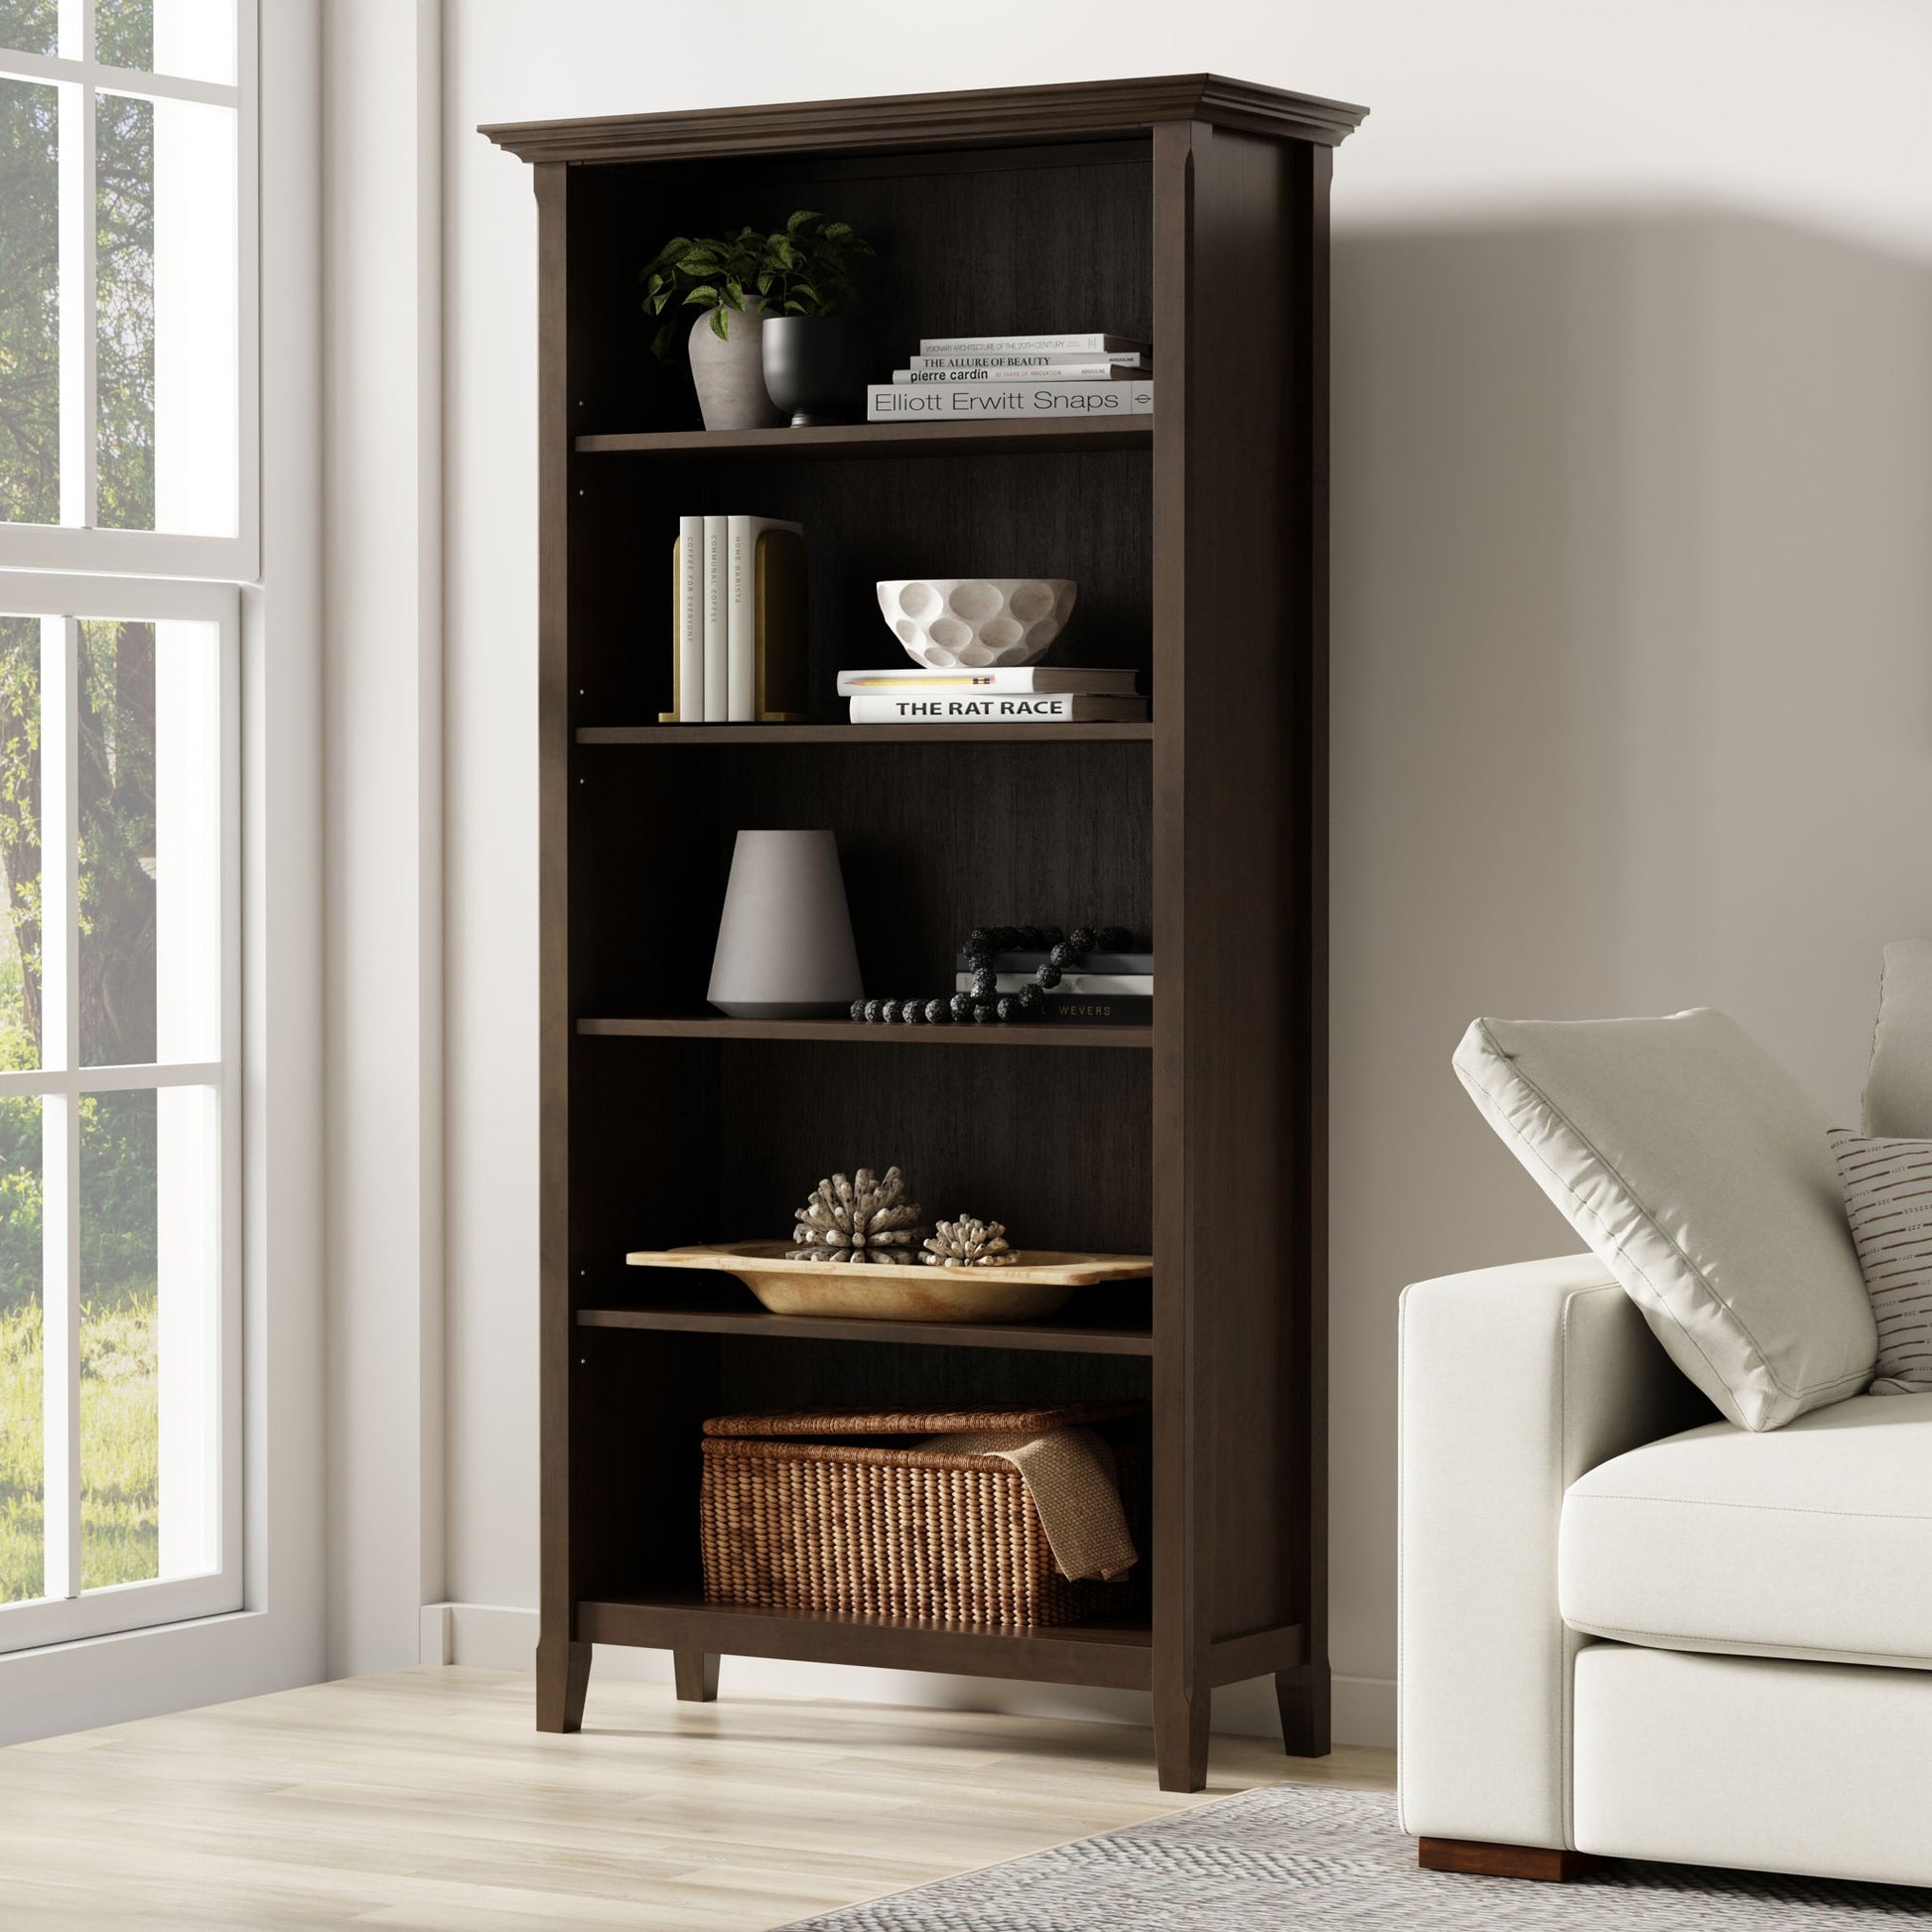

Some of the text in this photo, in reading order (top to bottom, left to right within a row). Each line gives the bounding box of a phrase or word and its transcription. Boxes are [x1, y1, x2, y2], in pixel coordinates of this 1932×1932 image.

[953, 343, 995, 351] ARCHITECTURE
[1005, 342, 1018, 350] THE
[1035, 341, 1065, 349] CENTURY
[923, 356, 1050, 367] THE ALLURE OF BEAUTY
[910, 368, 988, 383] pierre cardin
[876, 390, 1119, 412] Elliott Erwitt Snaps
[896, 700, 1063, 716] THE RAT RACE
[1059, 1006, 1112, 1017] WEVERS
